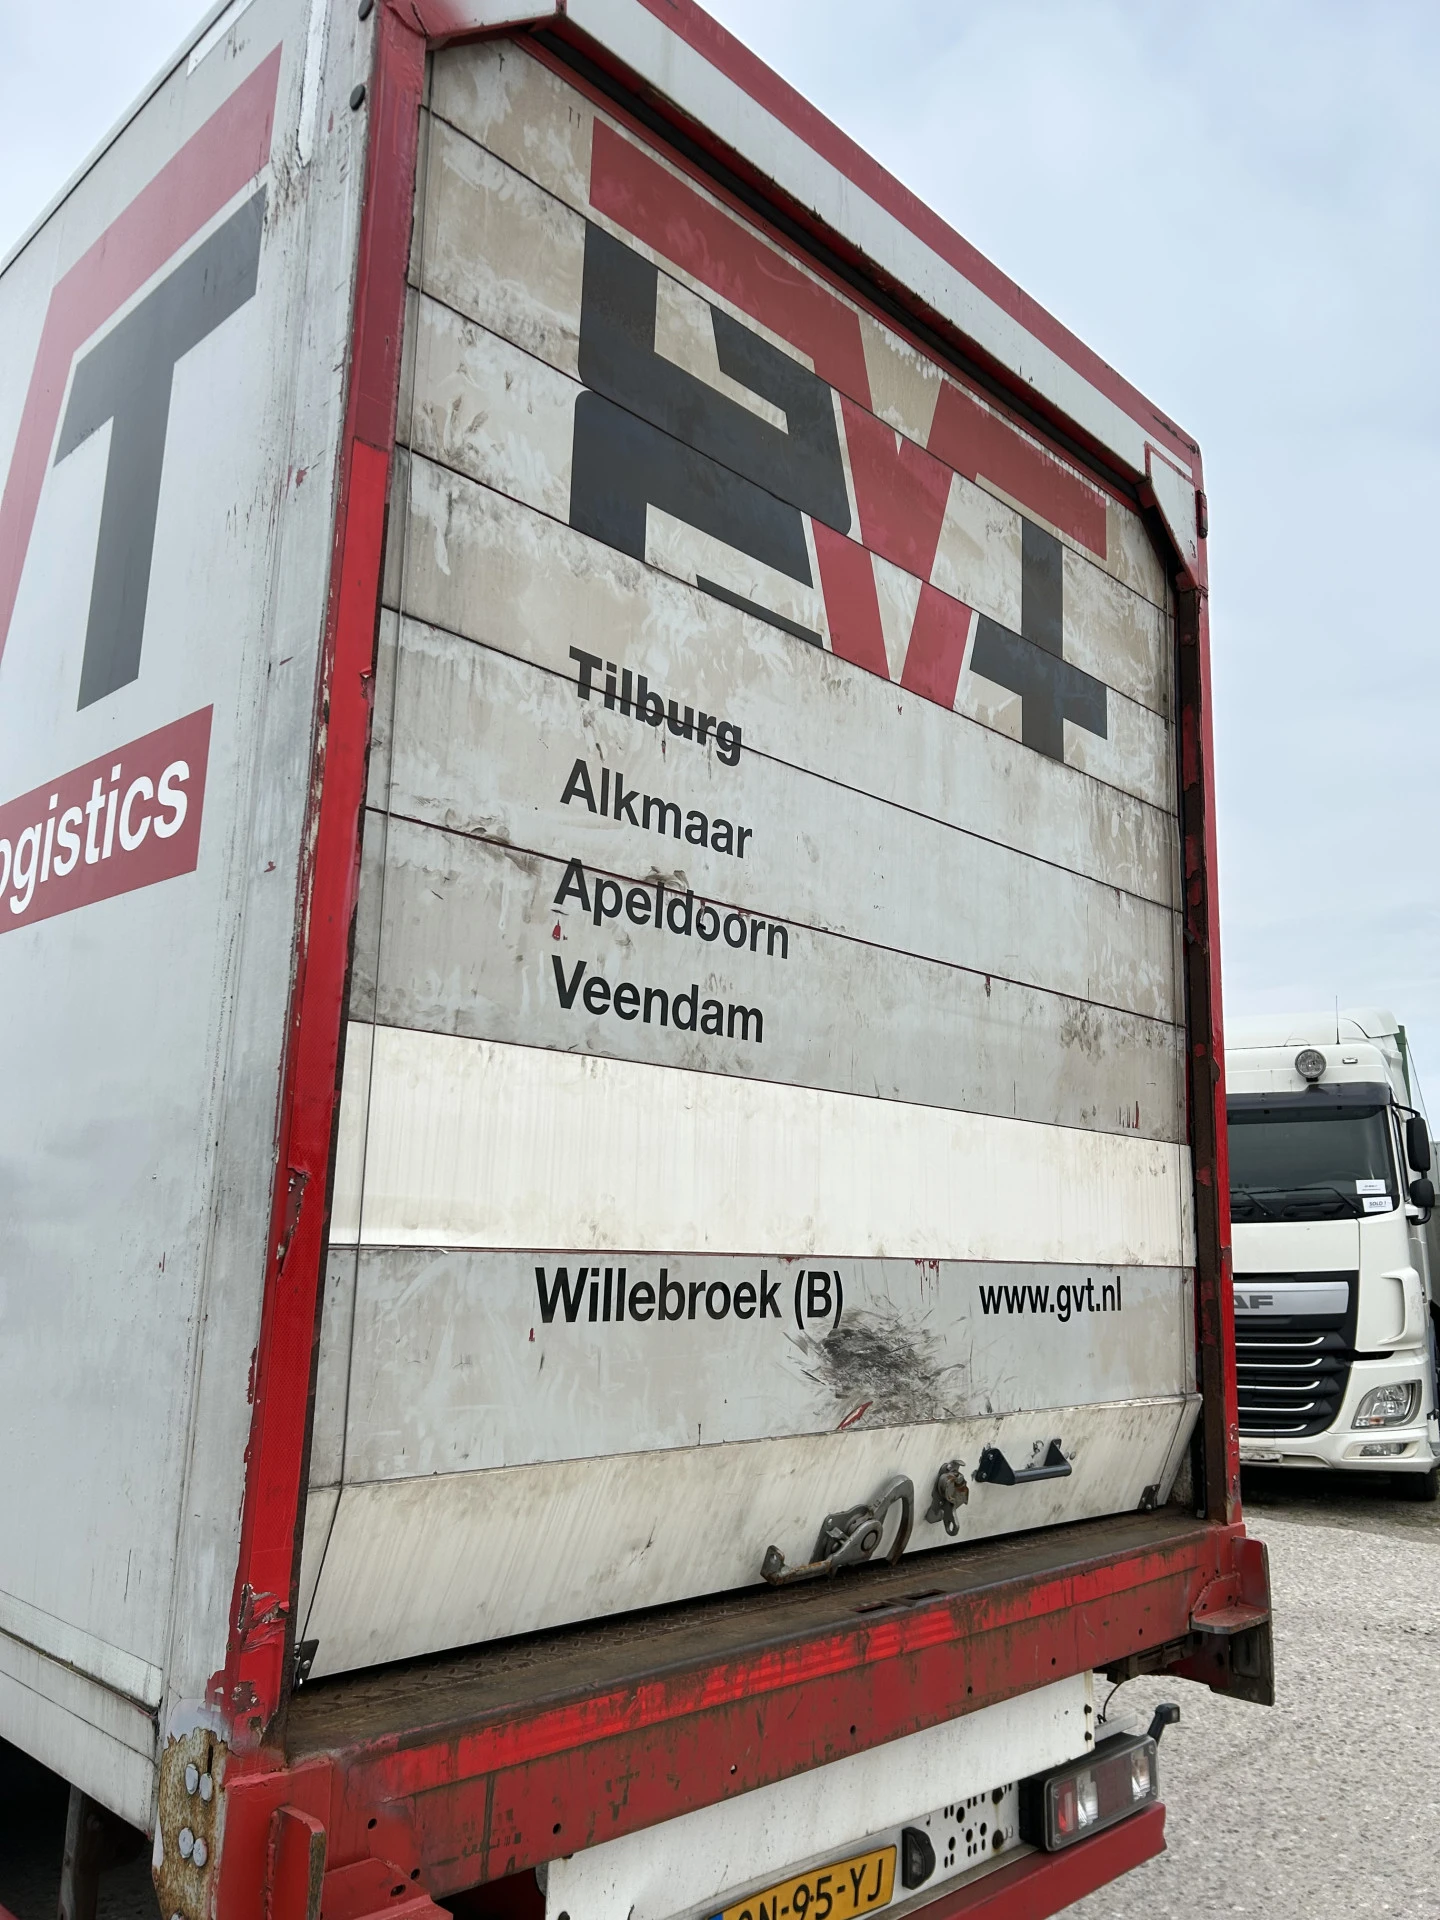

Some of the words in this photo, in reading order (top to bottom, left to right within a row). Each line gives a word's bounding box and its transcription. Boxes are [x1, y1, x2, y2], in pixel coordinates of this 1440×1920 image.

[569, 646, 742, 766] Tilburg
[560, 758, 752, 858] Alkmaar
[553, 857, 789, 959] Apeldoorn
[551, 955, 763, 1043] Veendam
[535, 1267, 782, 1323] Willebroek
[794, 1269, 843, 1330] (B)
[979, 1276, 1121, 1322] www.gvt.nl
[1234, 1295, 1273, 1309] AF
[738, 1858, 883, 1920] N-95-YJ
